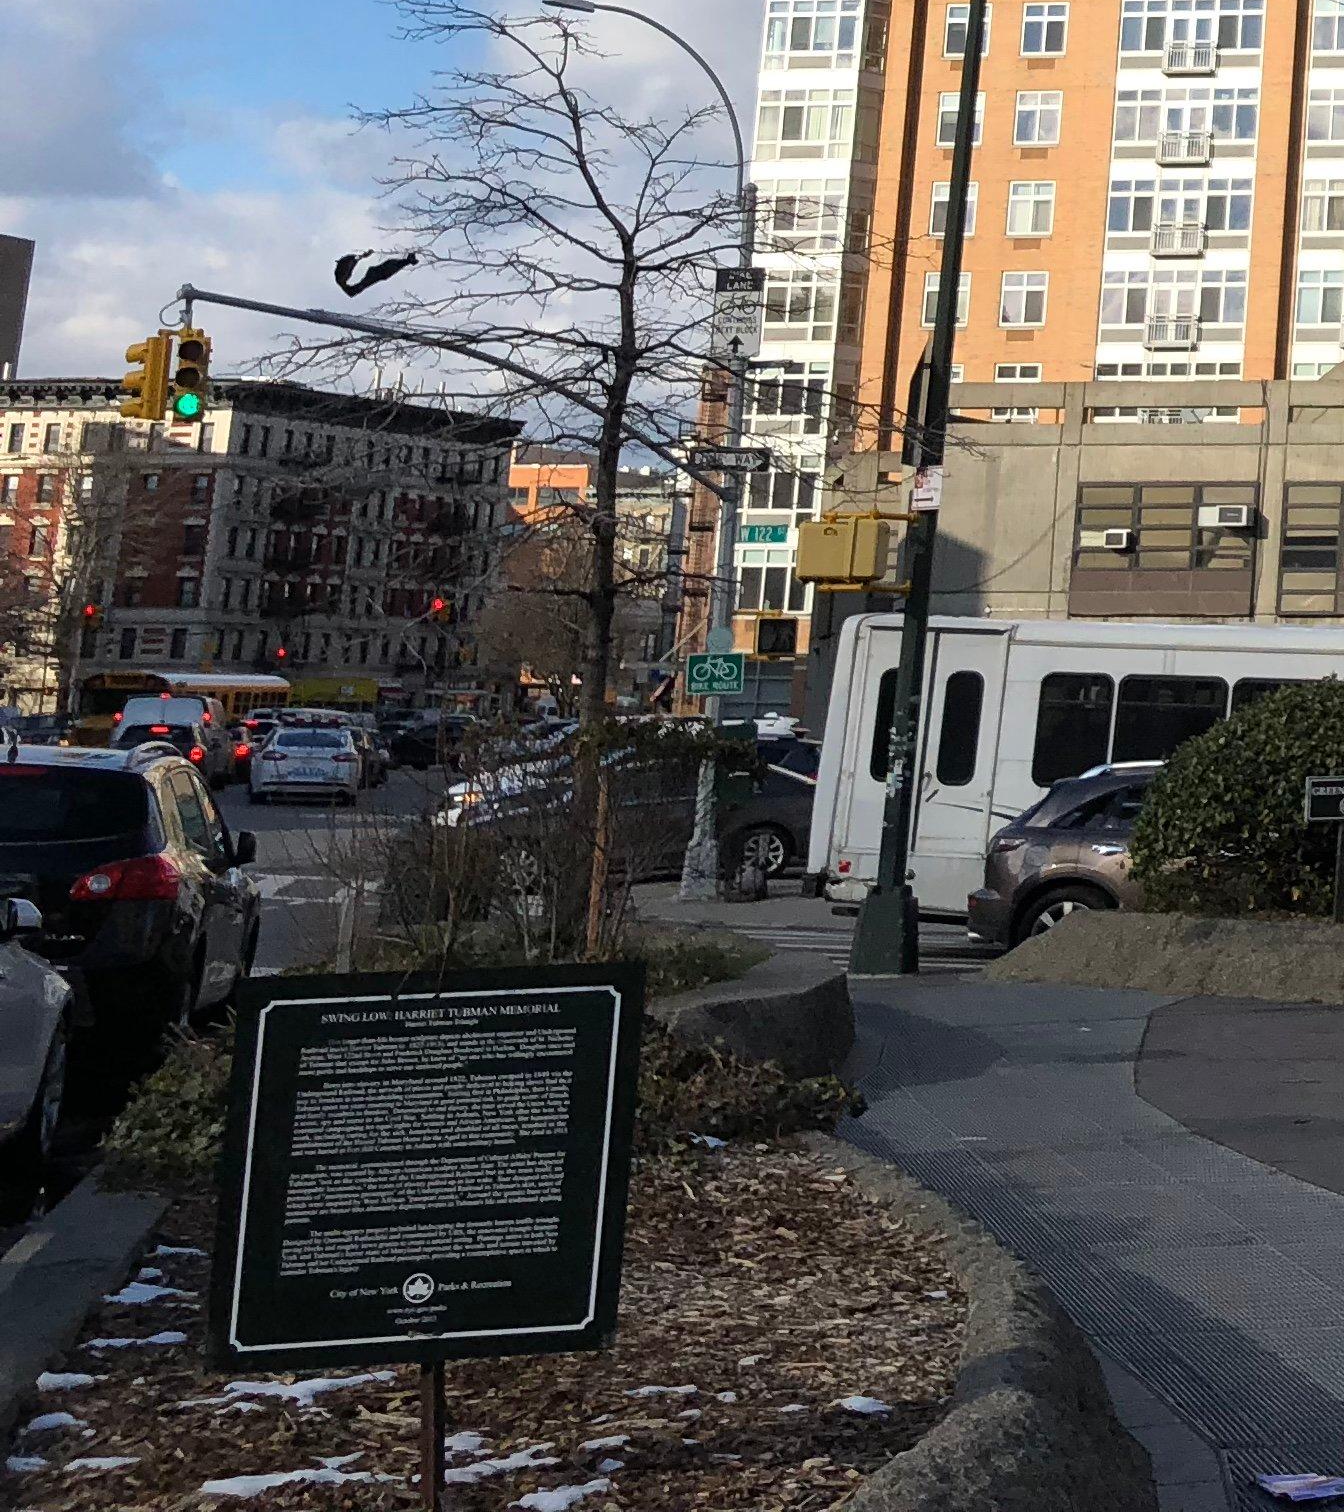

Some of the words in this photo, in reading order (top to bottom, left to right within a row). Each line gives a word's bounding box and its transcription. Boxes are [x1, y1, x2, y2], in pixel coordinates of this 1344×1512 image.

[741, 527, 750, 542] W
[755, 526, 773, 542] 122
[321, 1011, 360, 1025] SWING
[394, 1008, 445, 1021] HARRIET
[447, 1005, 498, 1018] TUBMAN
[499, 1003, 561, 1016] MEMORIAL
[329, 1289, 347, 1299] City
